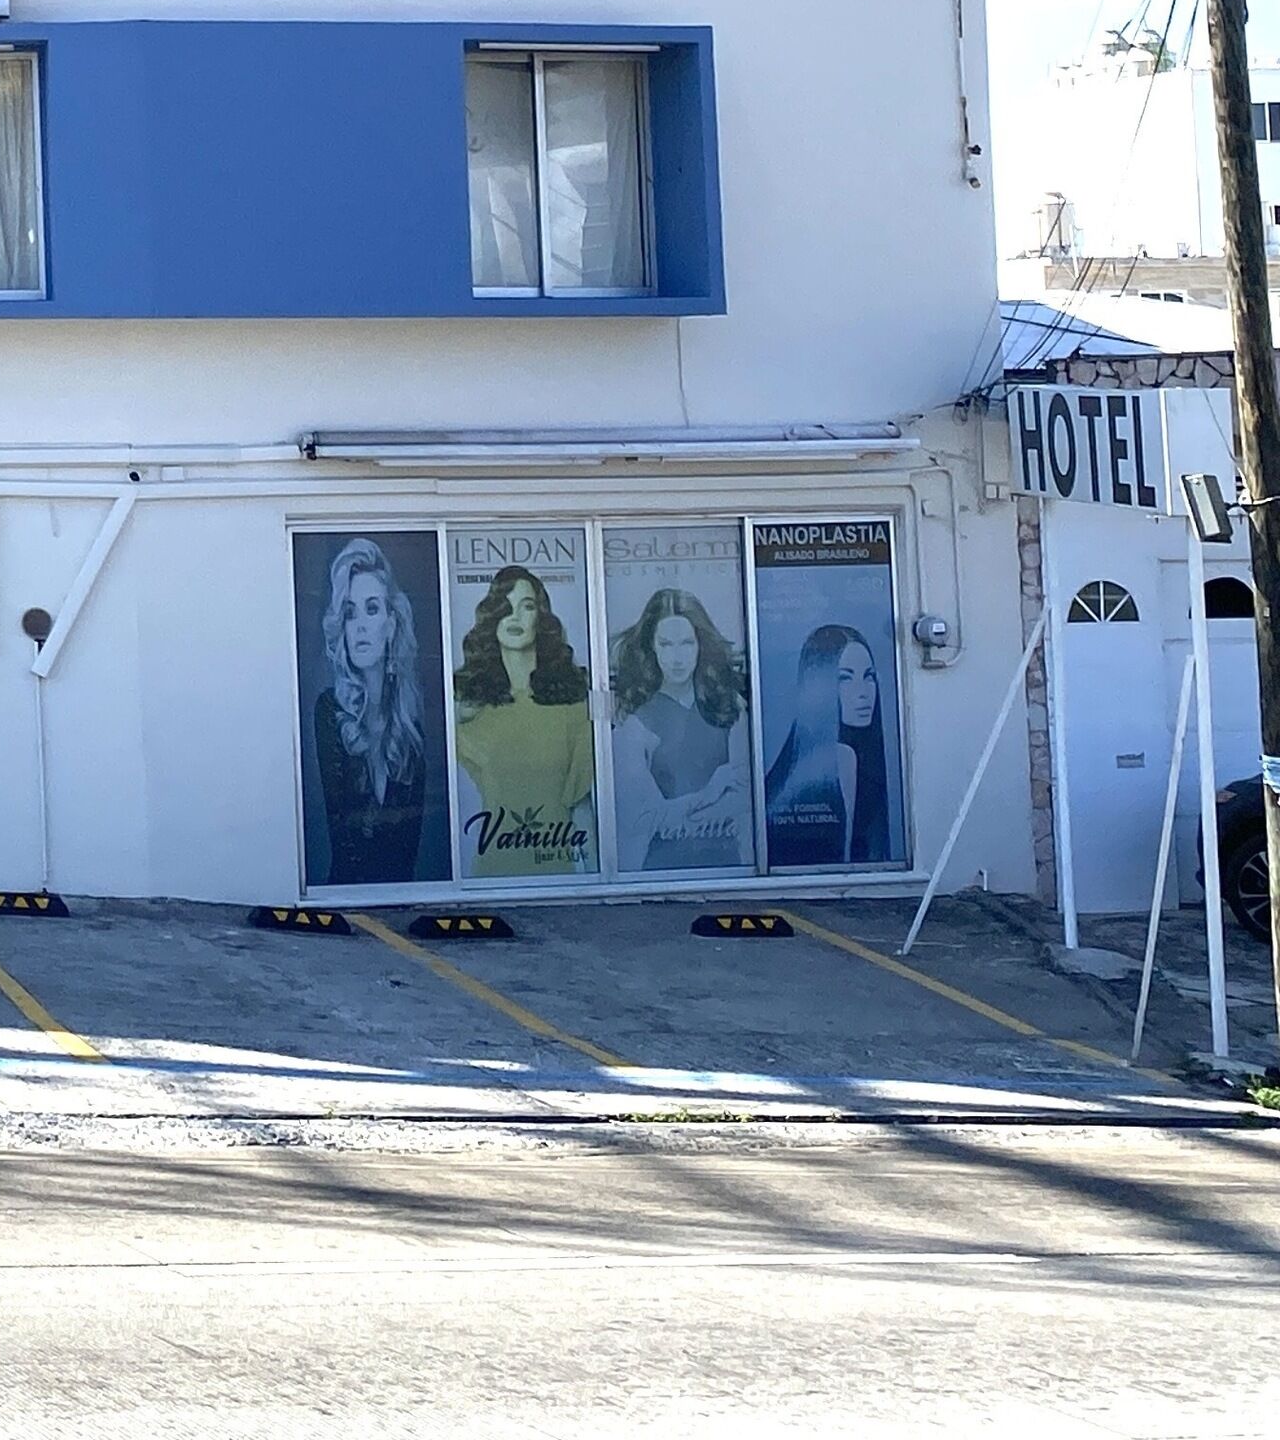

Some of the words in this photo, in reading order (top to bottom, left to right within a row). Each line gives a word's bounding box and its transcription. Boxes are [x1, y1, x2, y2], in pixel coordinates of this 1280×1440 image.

[1016, 389, 1158, 509] HOTEL
[755, 523, 888, 546] NANOPLASTIA
[455, 537, 576, 564] LENDAN
[774, 550, 815, 561] ALISADO
[463, 806, 589, 856] Vainilla
